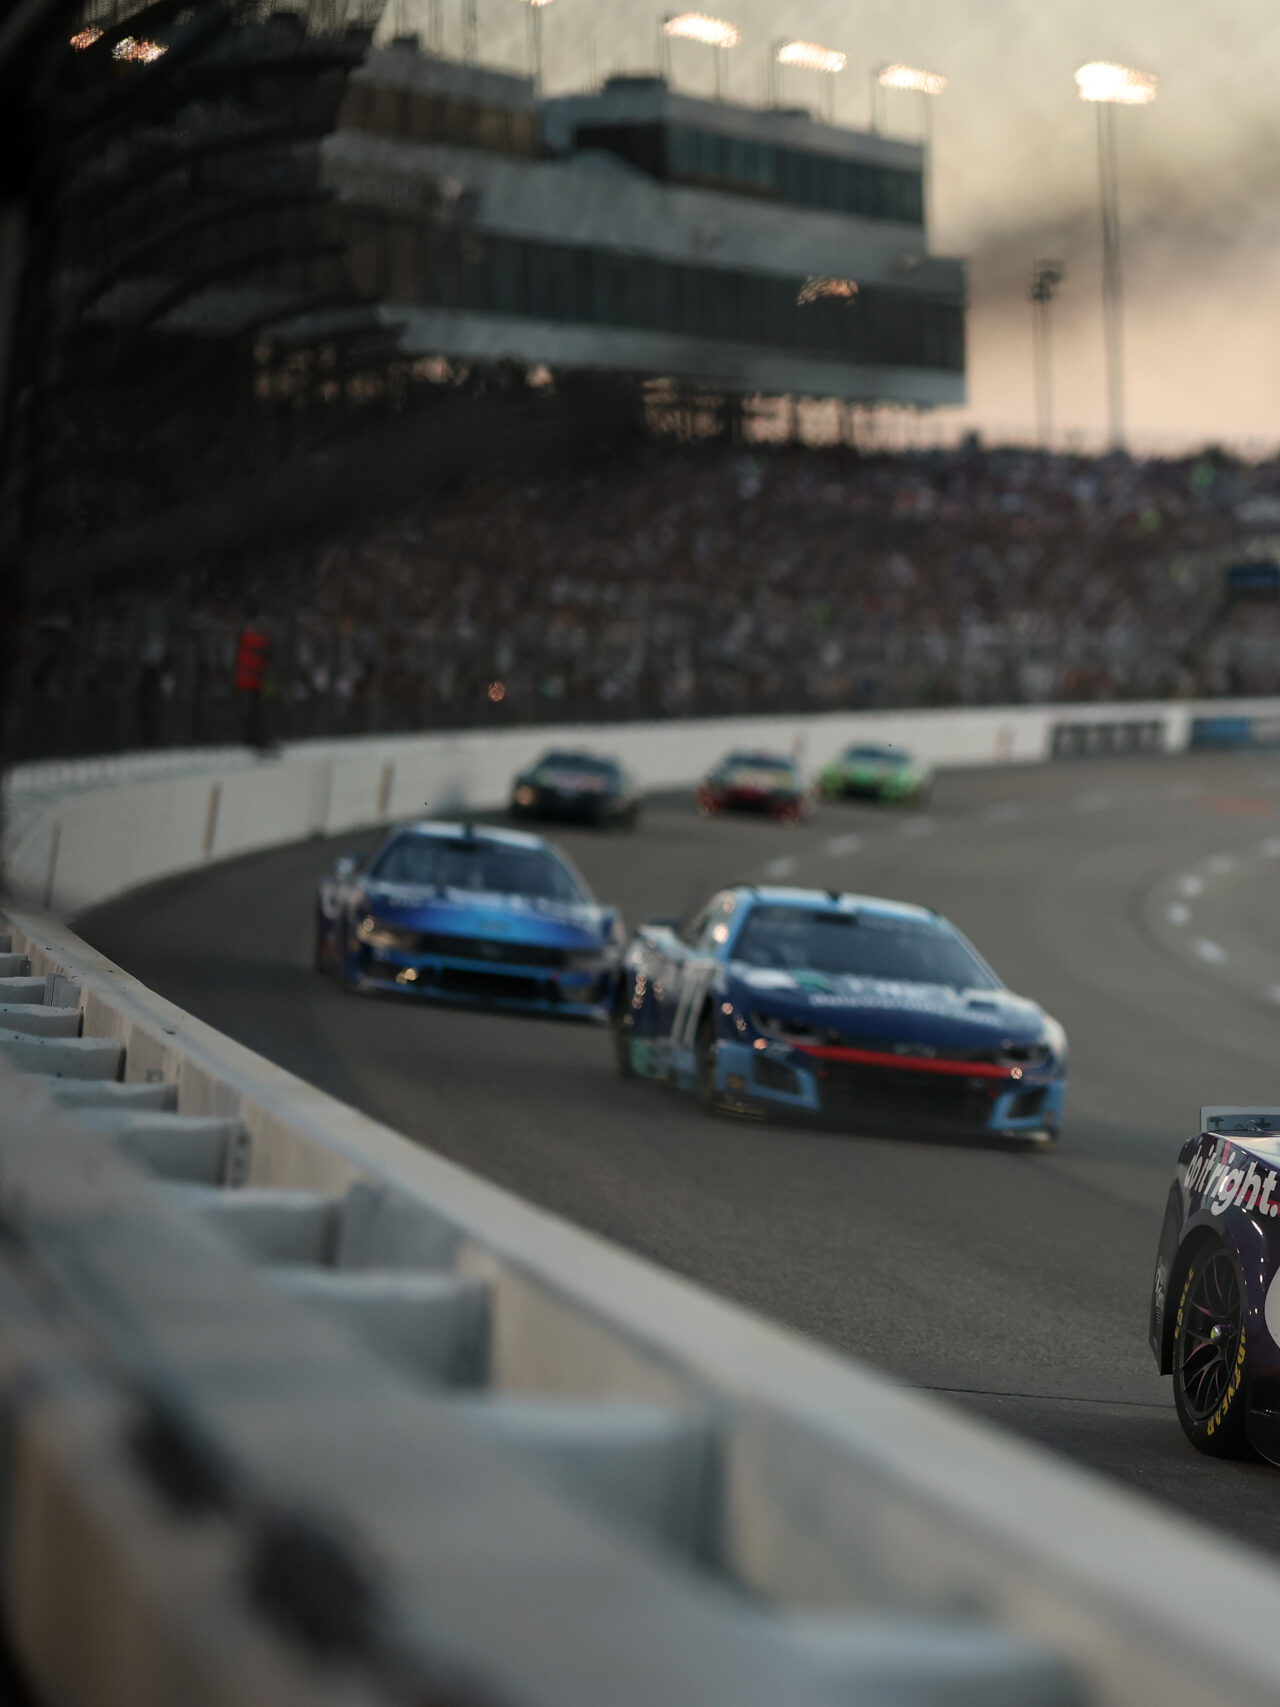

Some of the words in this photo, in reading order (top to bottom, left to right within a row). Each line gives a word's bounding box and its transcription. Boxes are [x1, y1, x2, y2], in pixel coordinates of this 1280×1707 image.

[1184, 1144, 1203, 1189] do
[1194, 1144, 1217, 1193] it
[1204, 1151, 1278, 1218] right.
